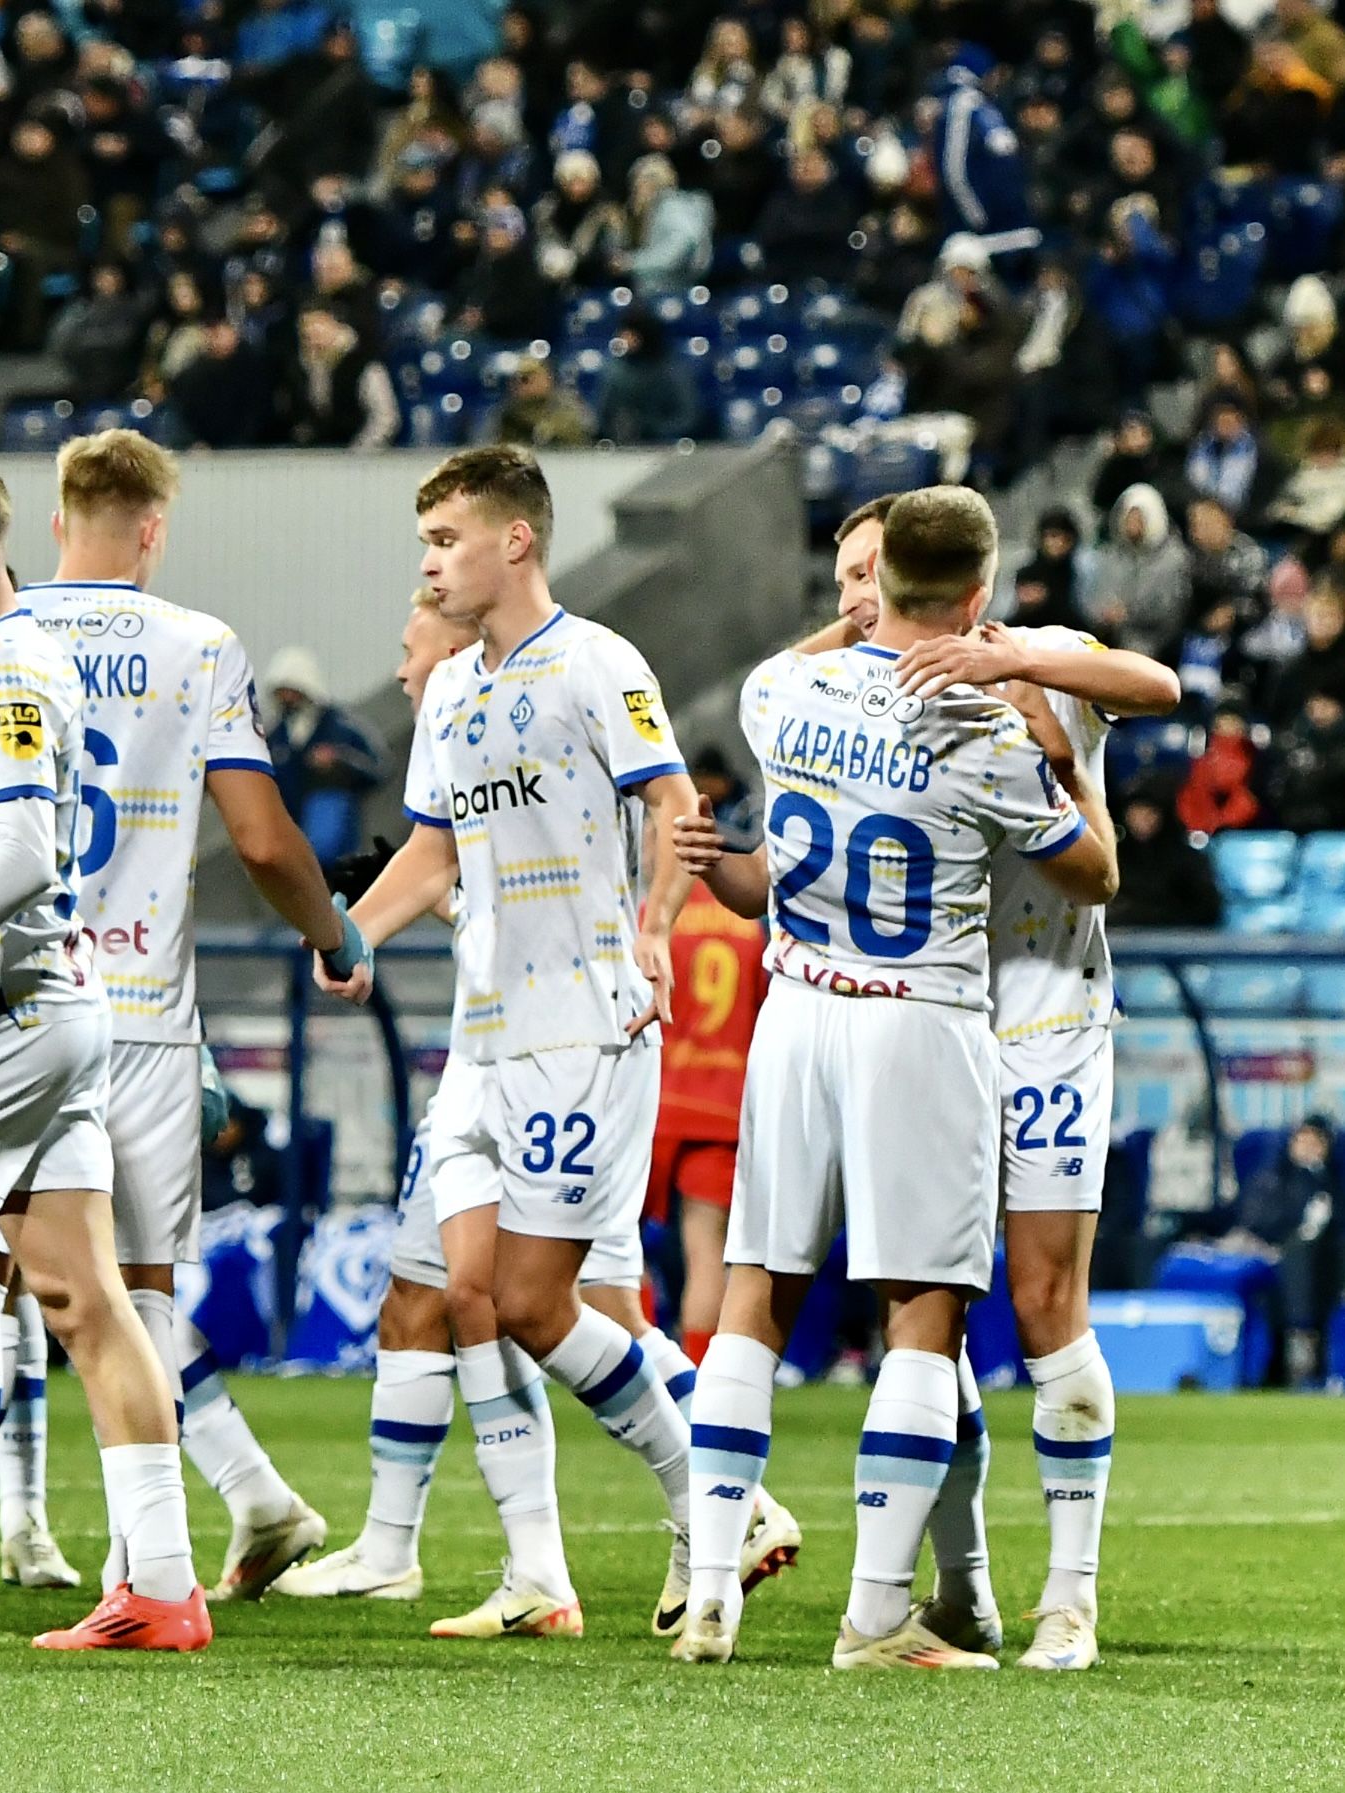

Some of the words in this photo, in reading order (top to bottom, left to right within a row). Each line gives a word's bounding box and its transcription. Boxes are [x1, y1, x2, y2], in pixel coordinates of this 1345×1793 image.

[73, 653, 148, 699] ЖКО
[810, 679, 861, 705] Money
[868, 693, 887, 708] 24
[905, 702, 914, 713] 7
[772, 715, 935, 793] КАРАВАЄВ
[450, 766, 548, 822] bank
[768, 791, 936, 959] 20
[692, 936, 740, 1036] 9
[522, 1111, 597, 1176] 32
[1013, 1082, 1088, 1151] 22
